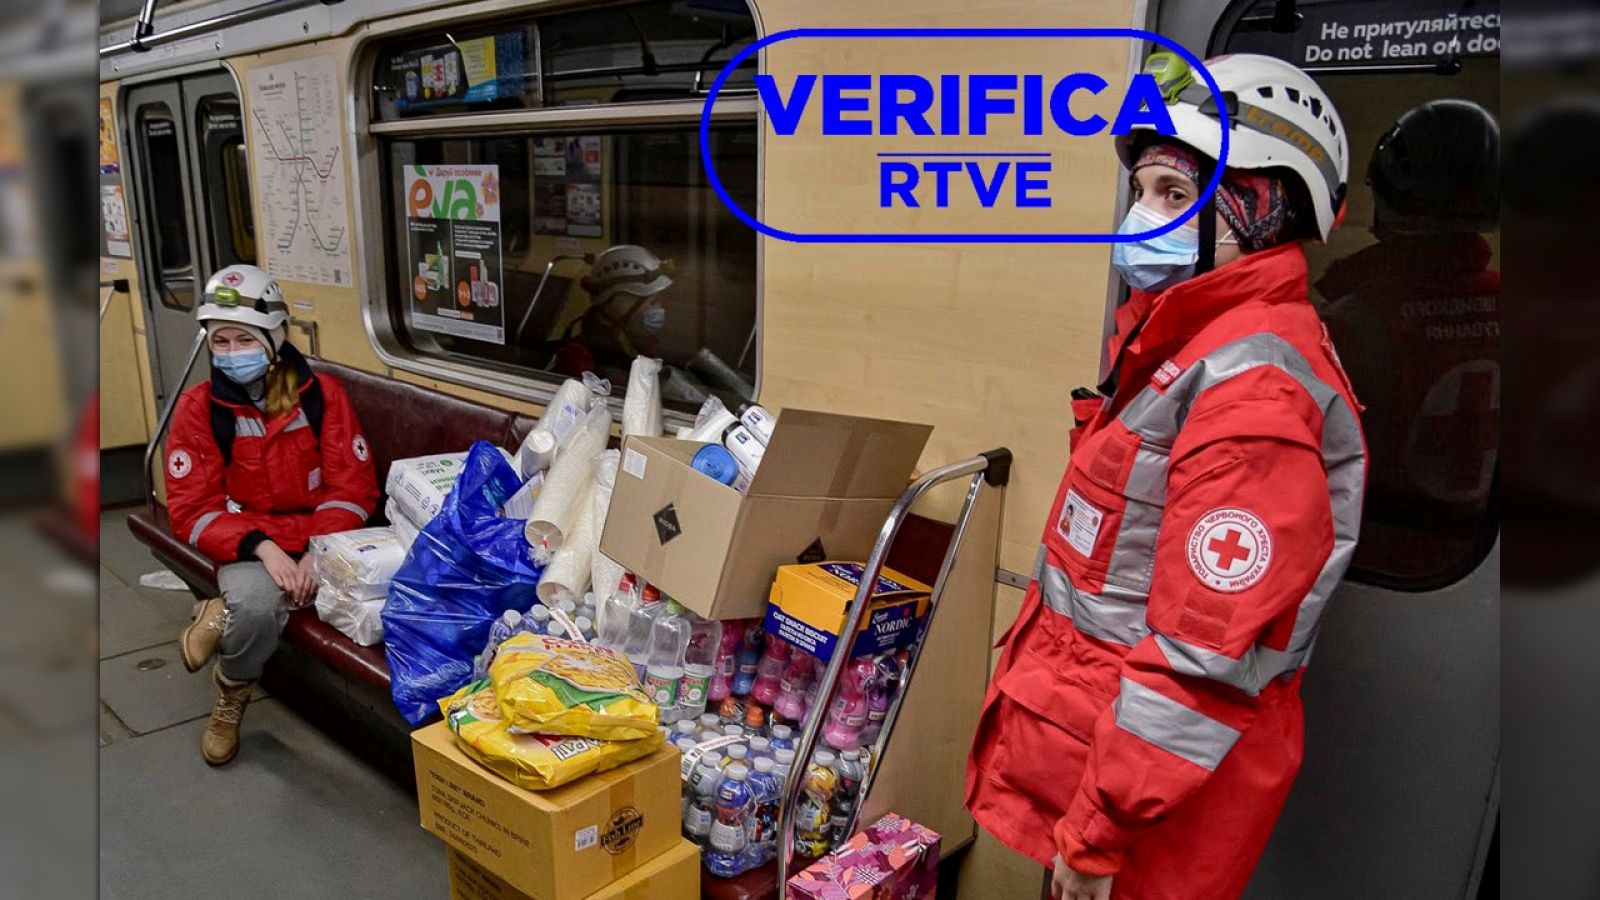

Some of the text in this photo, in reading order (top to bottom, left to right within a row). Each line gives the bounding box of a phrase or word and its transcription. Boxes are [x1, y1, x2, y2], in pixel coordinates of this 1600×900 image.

[1320, 22, 1349, 40] Не
[1305, 34, 1500, 62] Do not lean on do
[1190, 511, 1270, 588] ТОВАРИСТВО ЧЕРВОНОГО ХРЕСТА УКРАЇНИ
[874, 617, 912, 636] NORDIC
